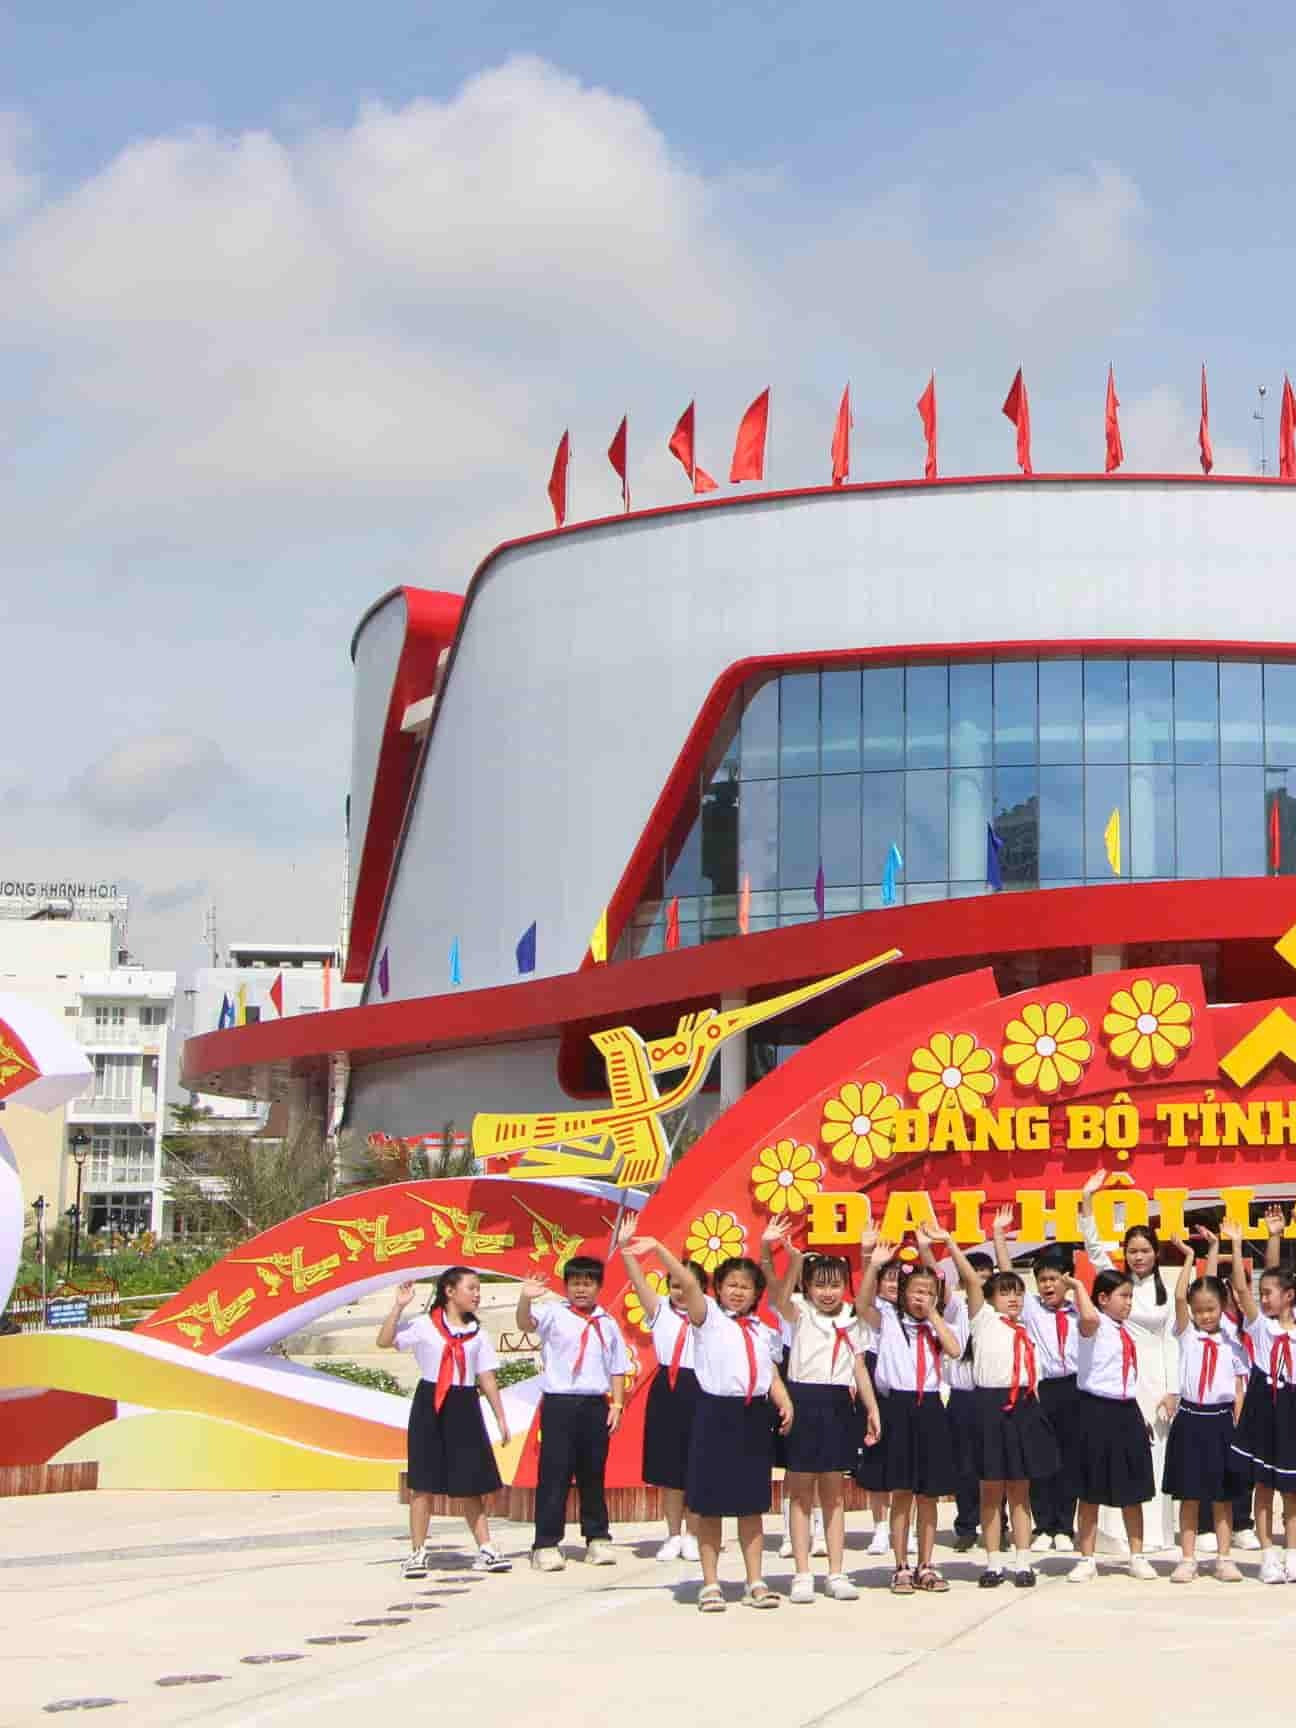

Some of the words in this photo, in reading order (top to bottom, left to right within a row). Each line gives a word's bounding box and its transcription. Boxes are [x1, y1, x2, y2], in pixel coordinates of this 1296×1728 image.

[891, 1091, 1050, 1153] ĐẢNG
[1066, 1092, 1140, 1161] BỘ
[807, 1190, 986, 1261] ĐẠI
